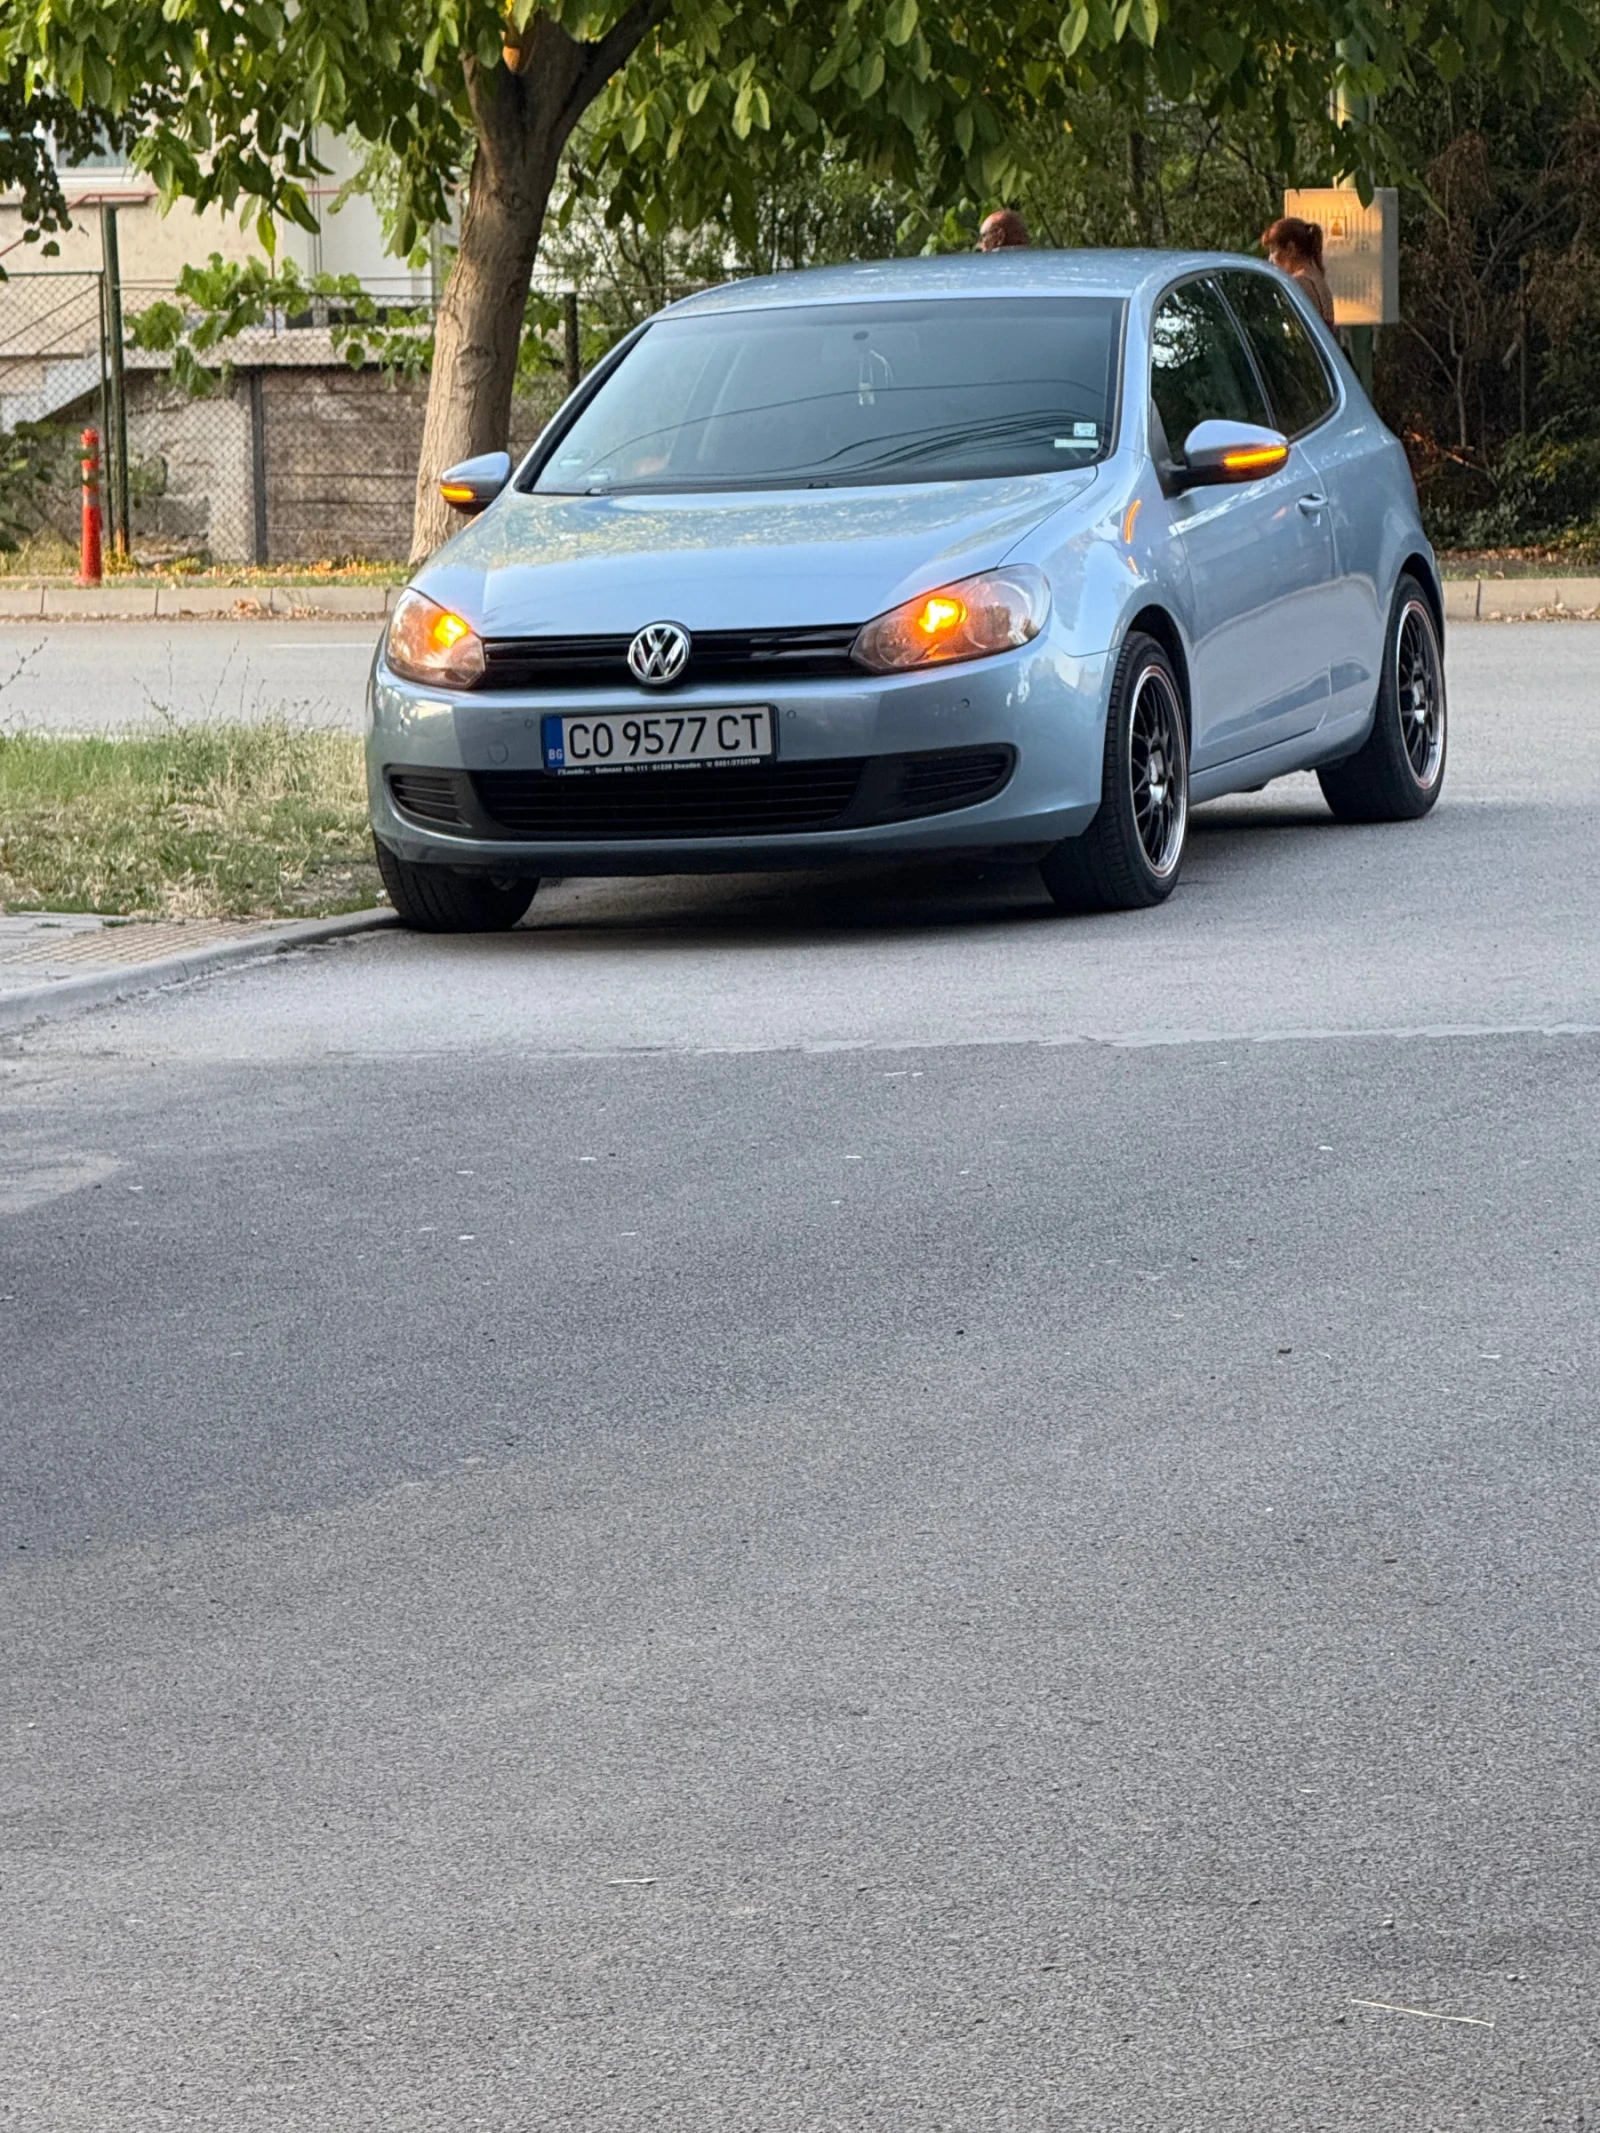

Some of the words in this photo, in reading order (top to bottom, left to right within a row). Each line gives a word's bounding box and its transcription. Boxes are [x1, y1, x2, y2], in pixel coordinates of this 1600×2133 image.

[569, 723, 613, 759] CO
[622, 716, 707, 756] 9577
[717, 713, 763, 750] CT
[548, 749, 563, 759] BG
